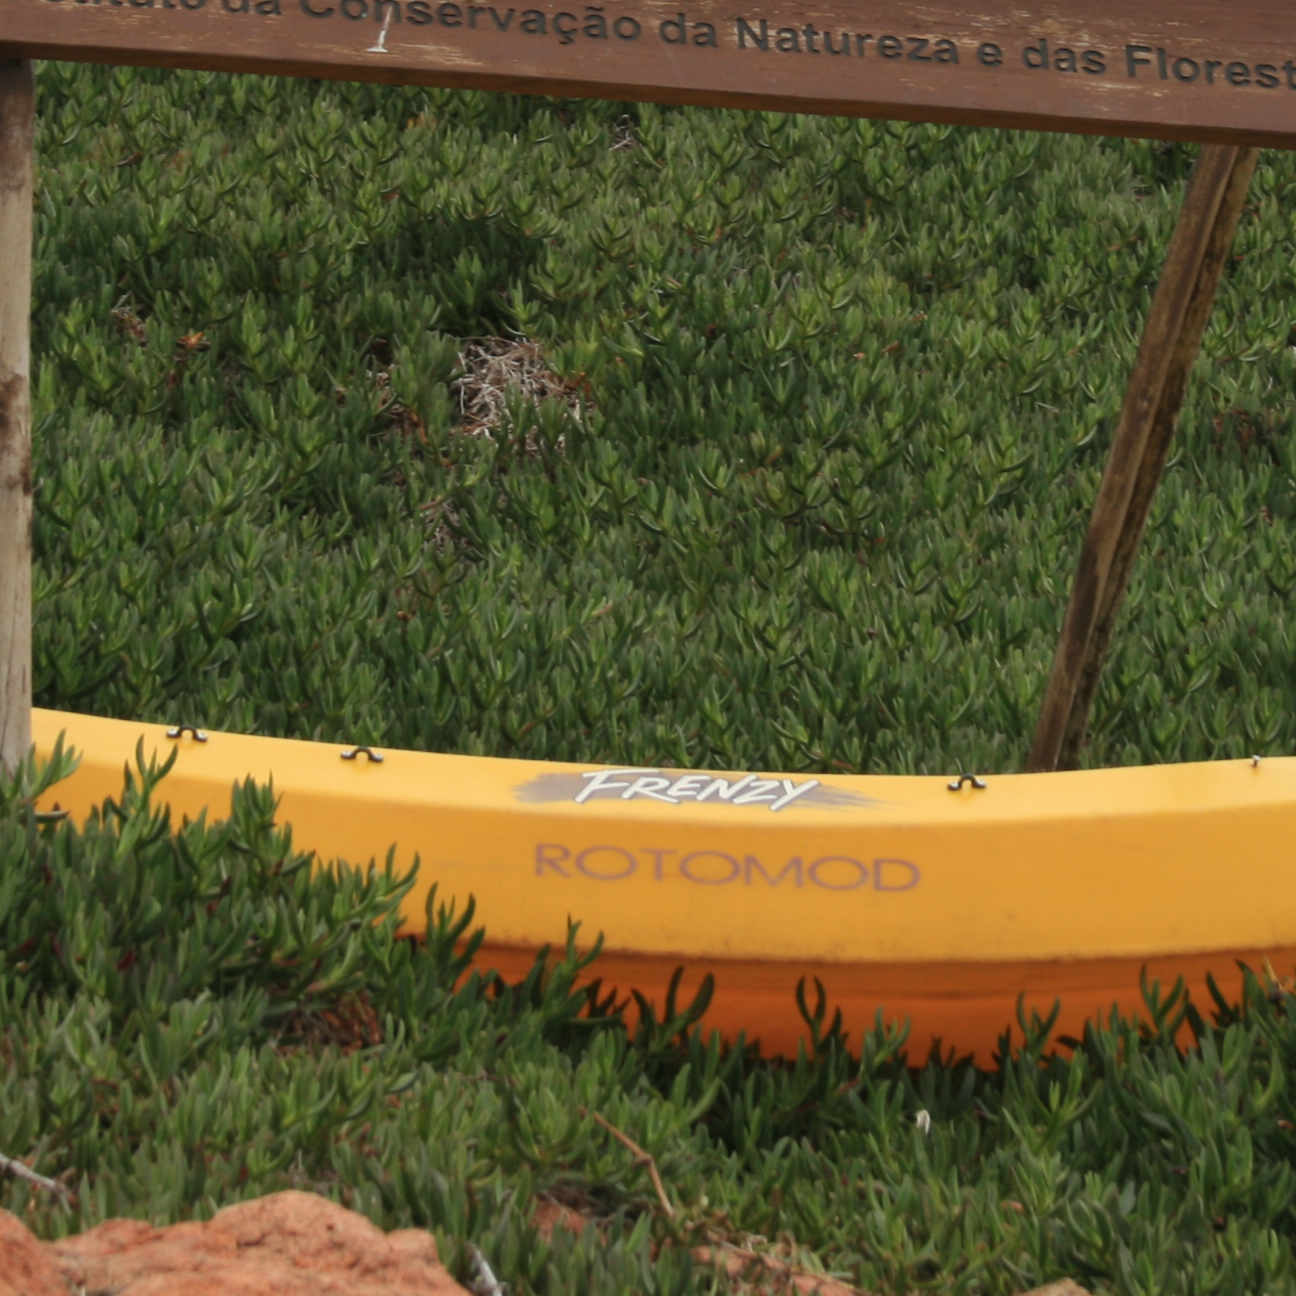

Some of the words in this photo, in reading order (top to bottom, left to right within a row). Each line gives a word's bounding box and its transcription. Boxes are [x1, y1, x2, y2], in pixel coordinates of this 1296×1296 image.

[659, 12, 718, 49] da
[735, 17, 958, 66] Natureza
[977, 43, 1004, 68] e
[1022, 38, 1107, 76] das
[575, 768, 821, 812] FRENZY
[534, 843, 921, 892] ROTOMOD
